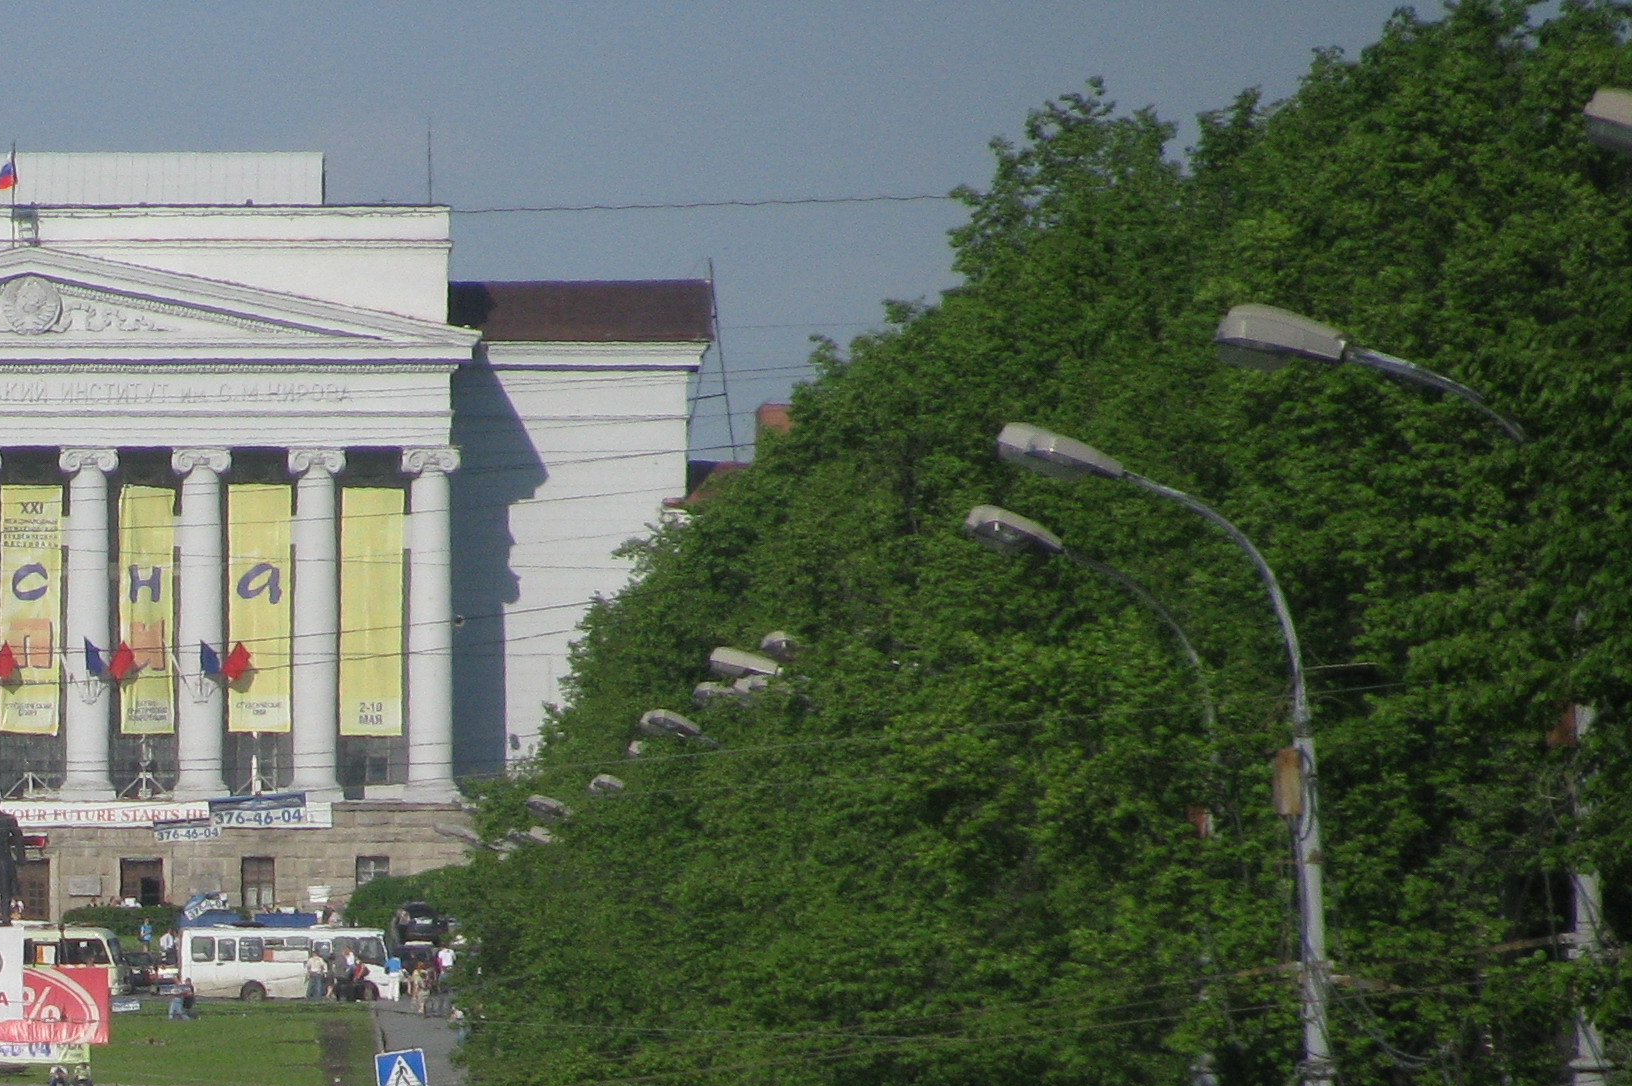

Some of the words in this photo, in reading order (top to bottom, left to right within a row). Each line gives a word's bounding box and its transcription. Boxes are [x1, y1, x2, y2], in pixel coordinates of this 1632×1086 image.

[52, 808, 116, 822] FUTURE
[121, 809, 180, 822] STARTS
[214, 809, 303, 826] 376-46-04
[156, 827, 219, 841] 376-46-04
